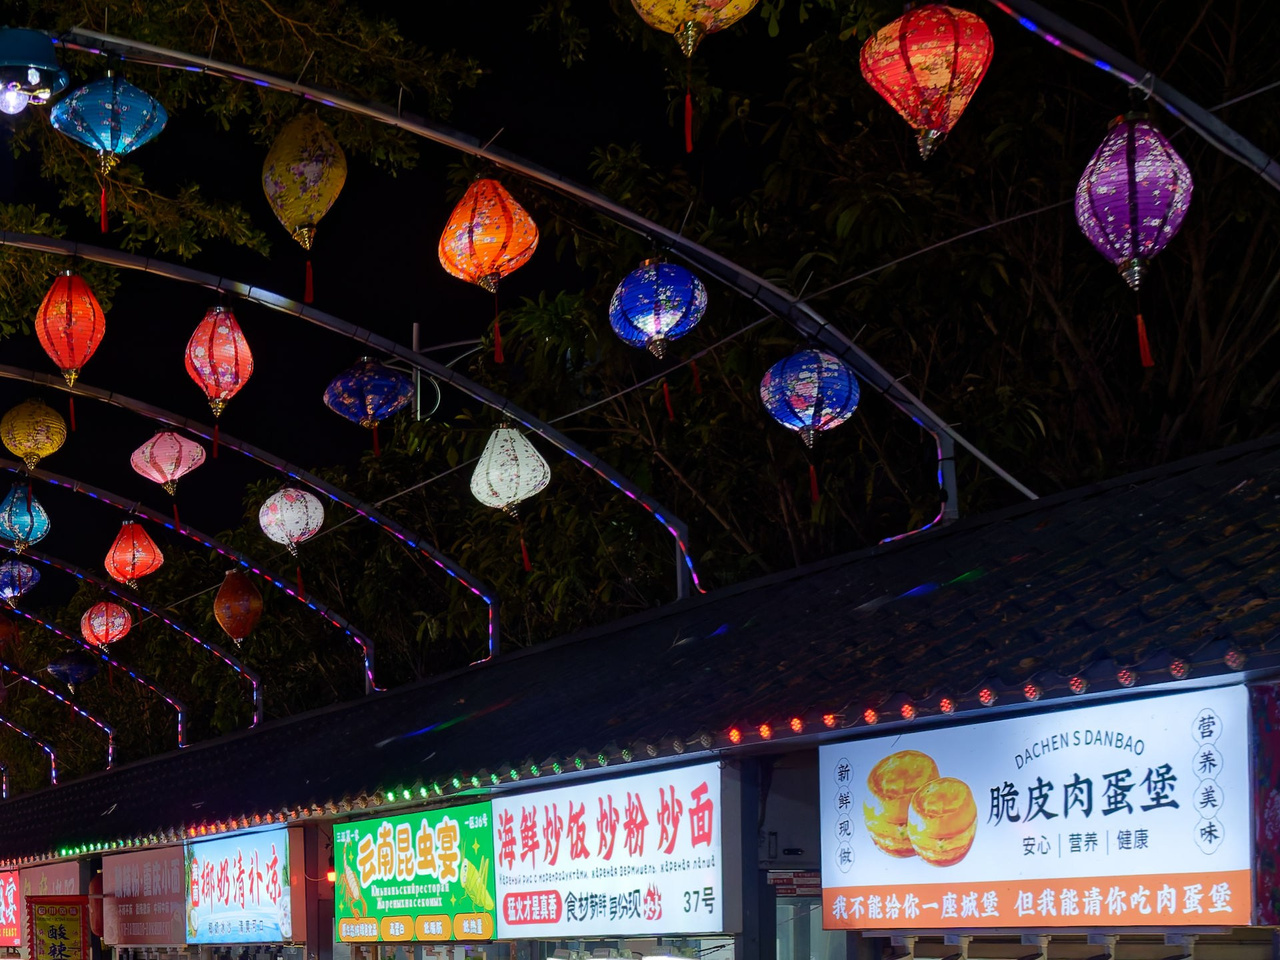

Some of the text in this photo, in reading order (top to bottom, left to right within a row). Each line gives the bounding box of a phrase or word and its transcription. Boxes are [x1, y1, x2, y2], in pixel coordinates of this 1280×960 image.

[1014, 731, 1070, 770] DACHEN
[1083, 729, 1145, 757] DANBAO
[986, 762, 1181, 826] 脆皮肉蛋堡
[1197, 714, 1219, 845] 营养美味
[836, 763, 854, 866] 新鲜现做
[357, 818, 460, 887] 云南昆虫宴
[1022, 828, 1149, 856] 安心 营养 健康
[201, 844, 282, 914] 椰奶清补凉
[506, 893, 558, 922] 猛火才是真香
[682, 886, 716, 914] 37号
[832, 881, 1234, 921] 我不能给你一座城堡 但我能请你吃肉蛋堡
[2, 927, 18, 938] FEAST
